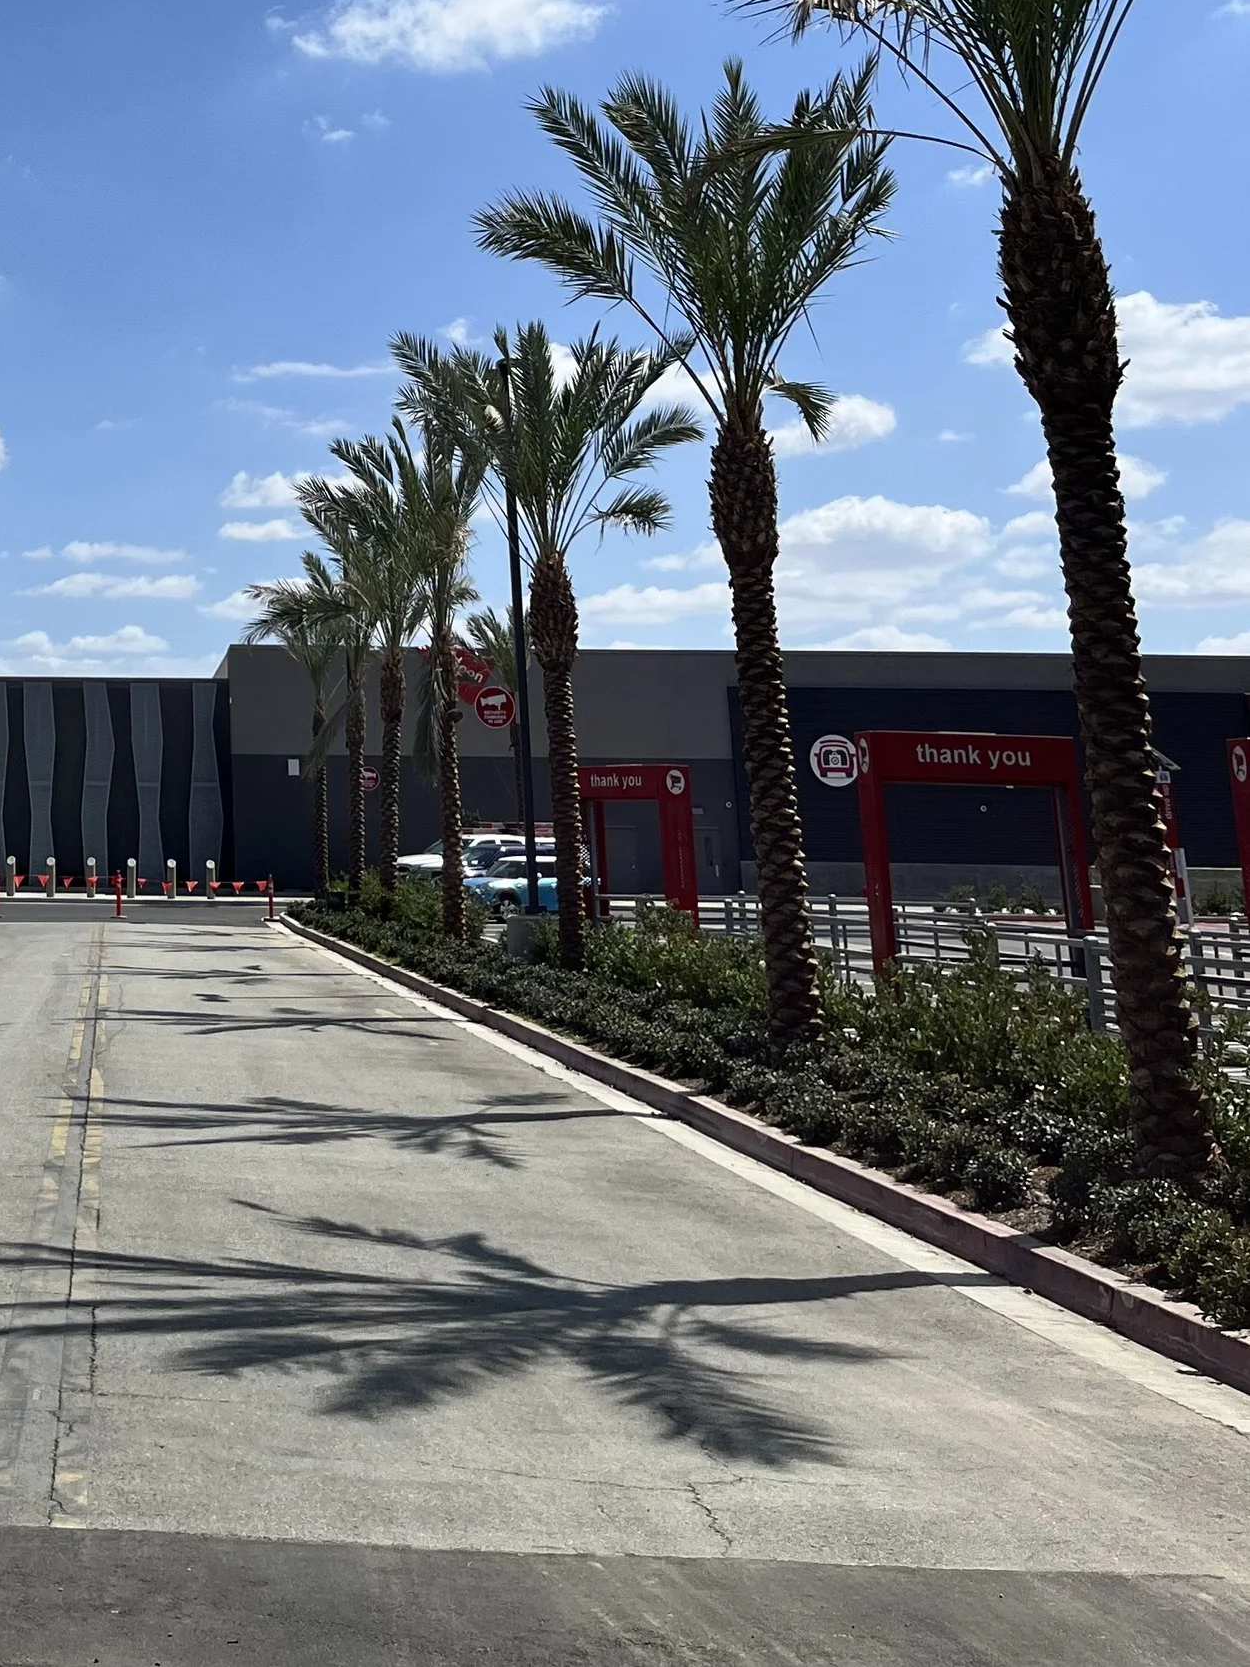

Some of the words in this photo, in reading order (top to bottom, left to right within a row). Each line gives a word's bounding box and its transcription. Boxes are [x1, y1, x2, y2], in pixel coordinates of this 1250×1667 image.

[915, 743, 981, 764] thank
[987, 750, 1031, 770] you
[590, 773, 620, 787] thank
[622, 775, 642, 790] you
